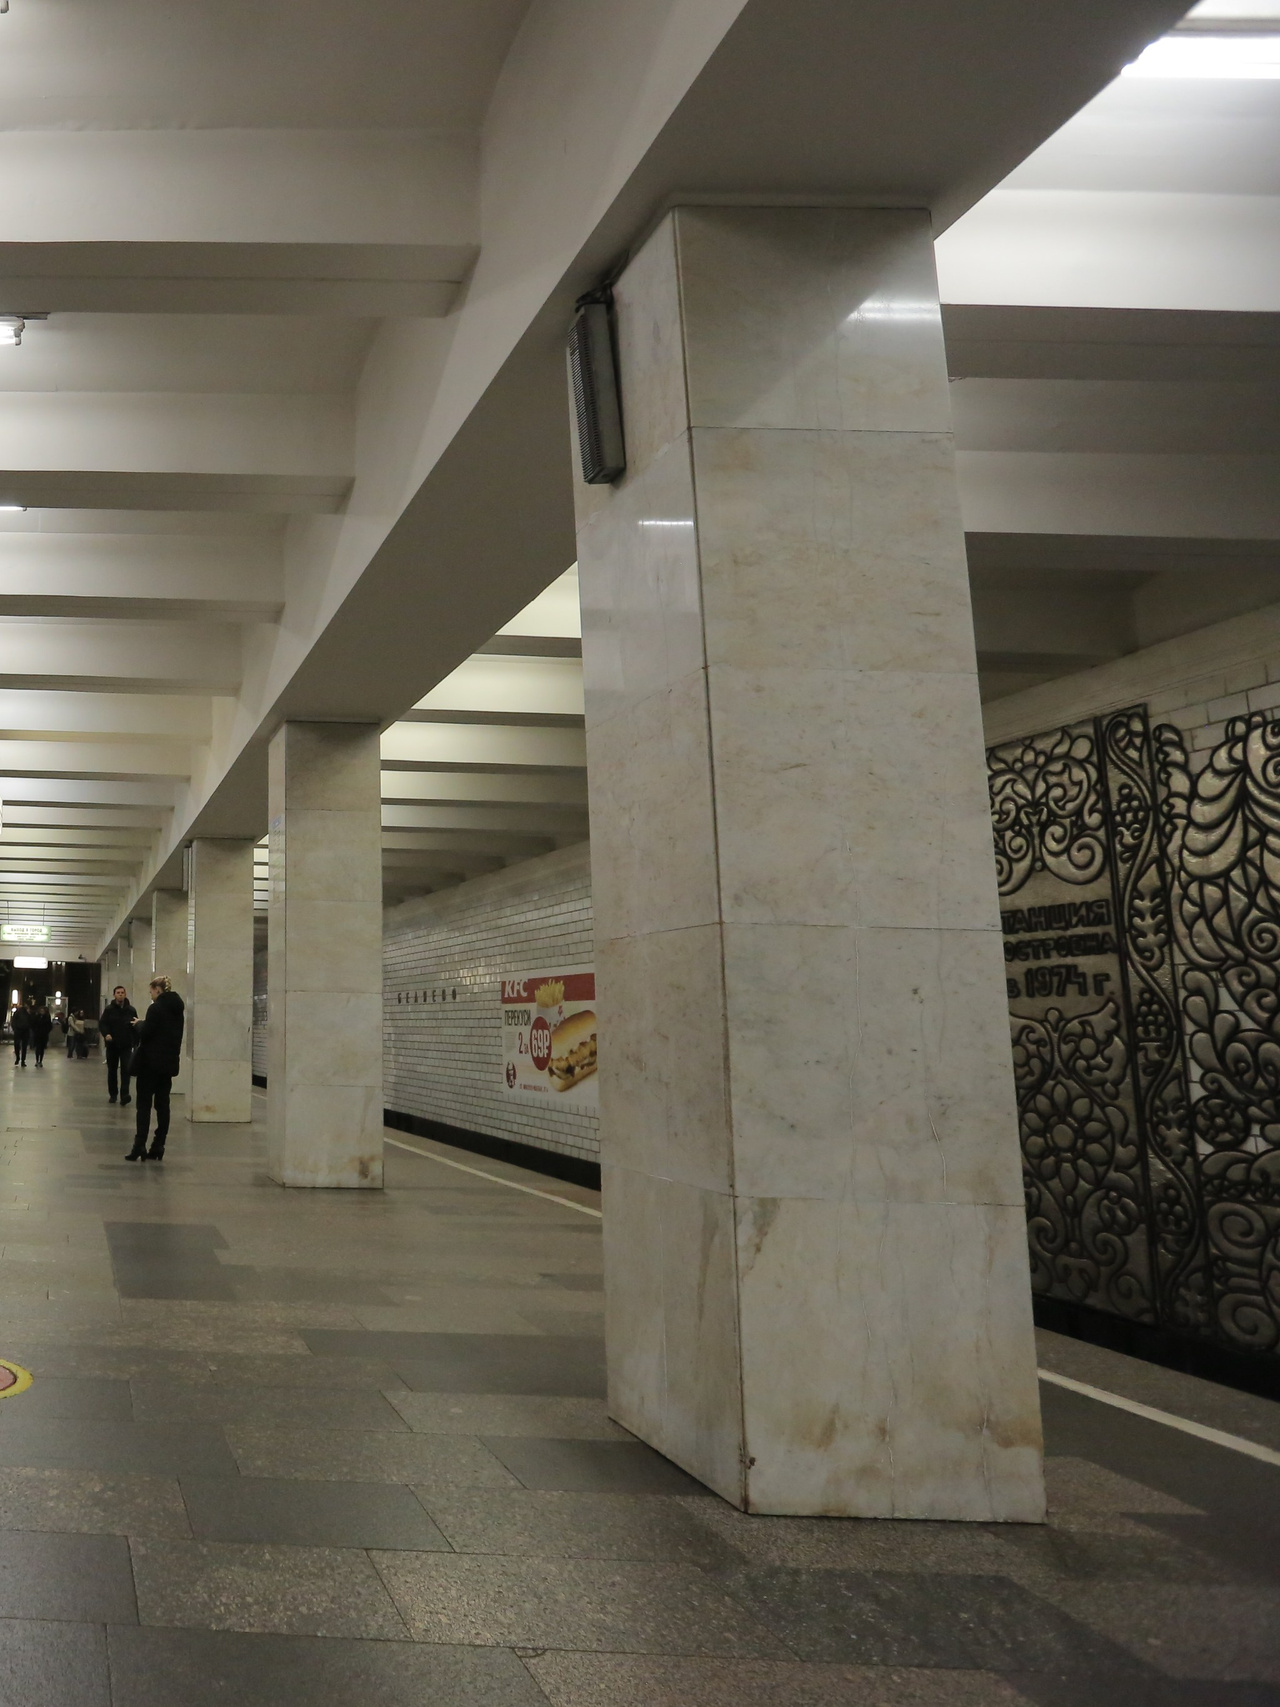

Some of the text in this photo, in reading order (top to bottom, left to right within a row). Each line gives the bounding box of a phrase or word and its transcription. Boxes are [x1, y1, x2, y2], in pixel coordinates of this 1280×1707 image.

[504, 979, 528, 998] KFC
[1025, 964, 1088, 998] 1974
[504, 1009, 531, 1027] ПЕРЕКУСИ
[518, 1031, 523, 1055] 2
